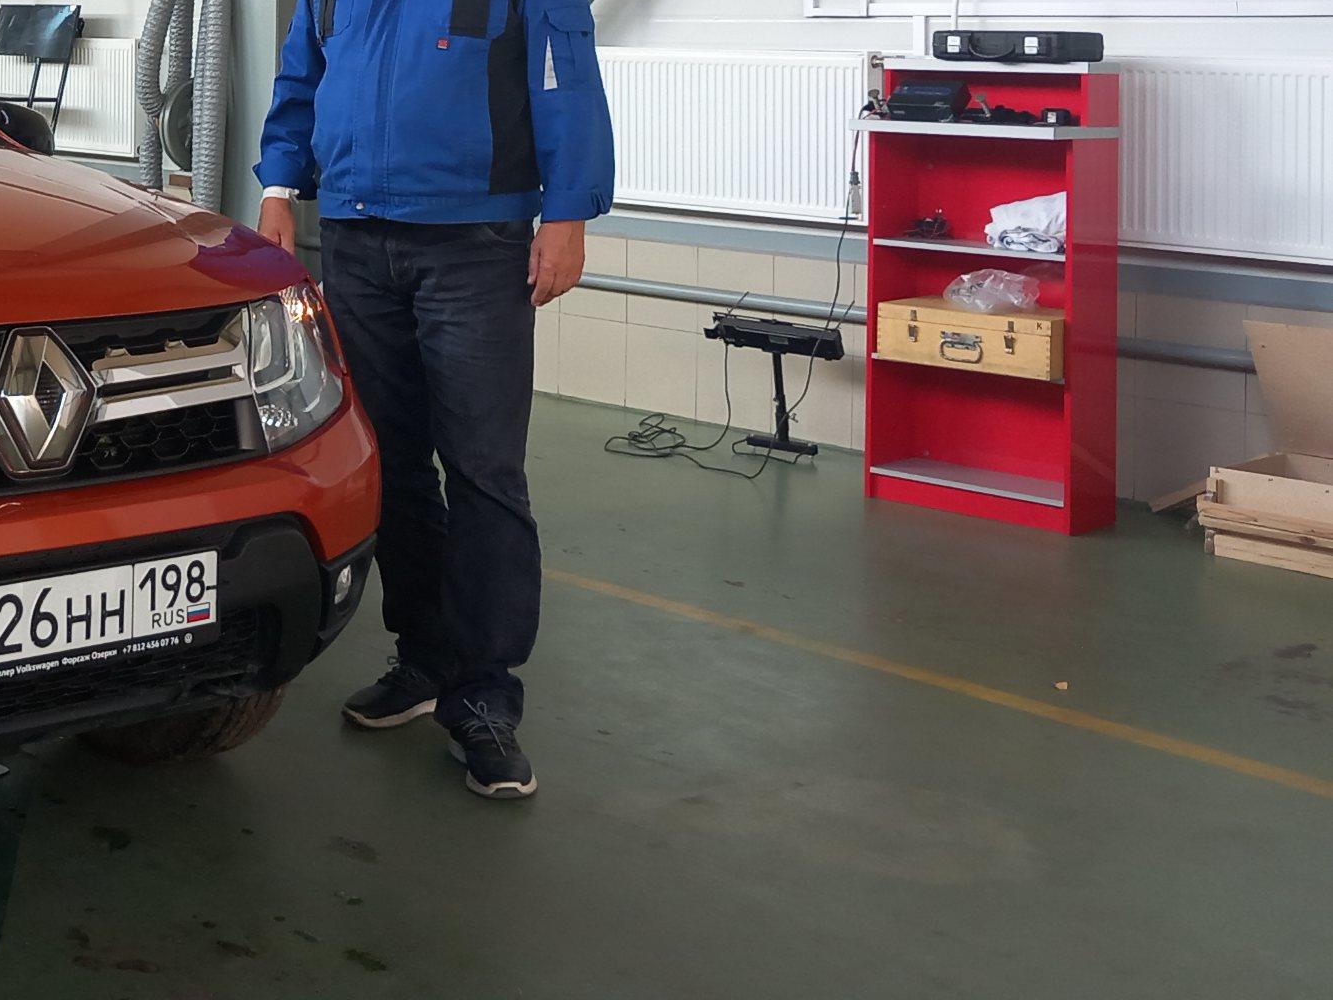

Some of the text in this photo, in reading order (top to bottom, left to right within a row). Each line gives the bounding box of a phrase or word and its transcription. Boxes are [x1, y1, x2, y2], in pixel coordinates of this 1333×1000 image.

[139, 560, 205, 611] 198
[151, 609, 185, 629] RUS
[16, 660, 59, 674] Volkswagen
[91, 649, 117, 660] Озерки
